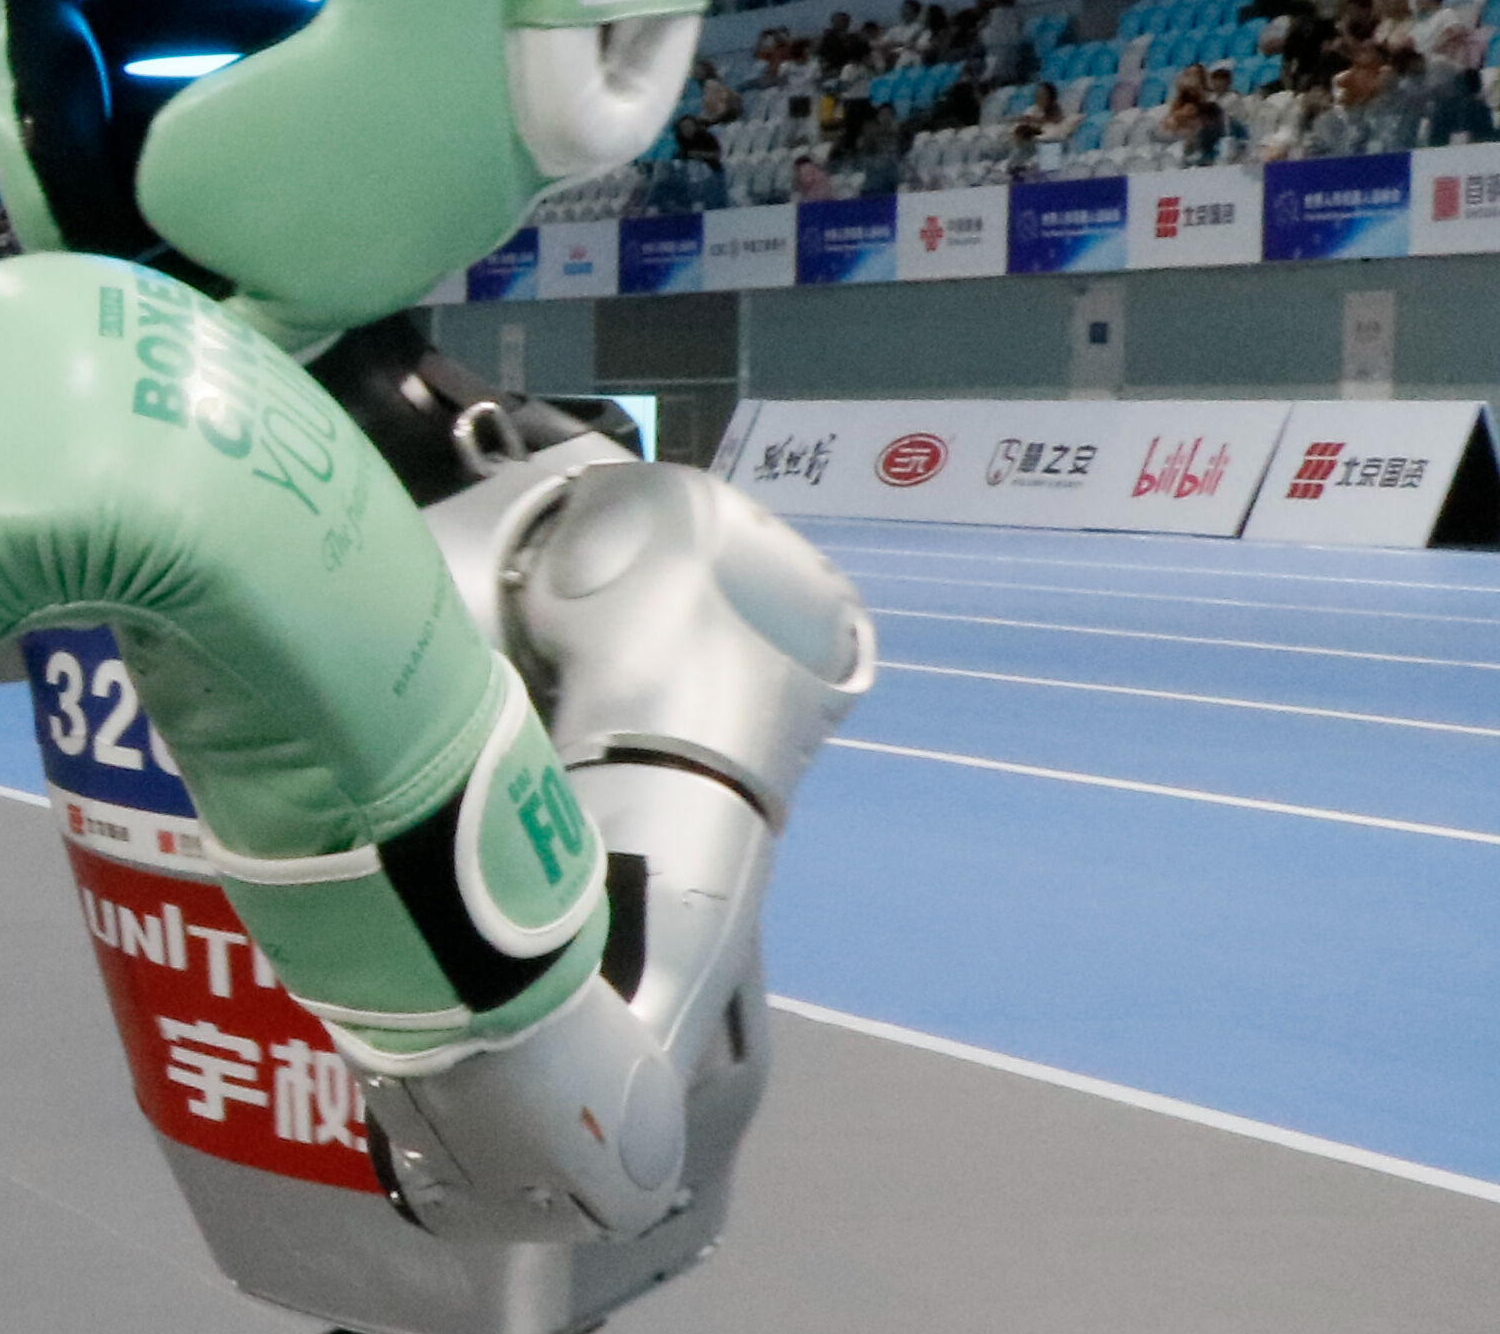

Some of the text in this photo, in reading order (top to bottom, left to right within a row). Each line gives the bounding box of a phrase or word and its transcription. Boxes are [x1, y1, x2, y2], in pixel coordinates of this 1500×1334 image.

[1131, 436, 1230, 499] bilibili
[1335, 456, 1431, 490] 北京国资
[46, 651, 184, 777] 32
